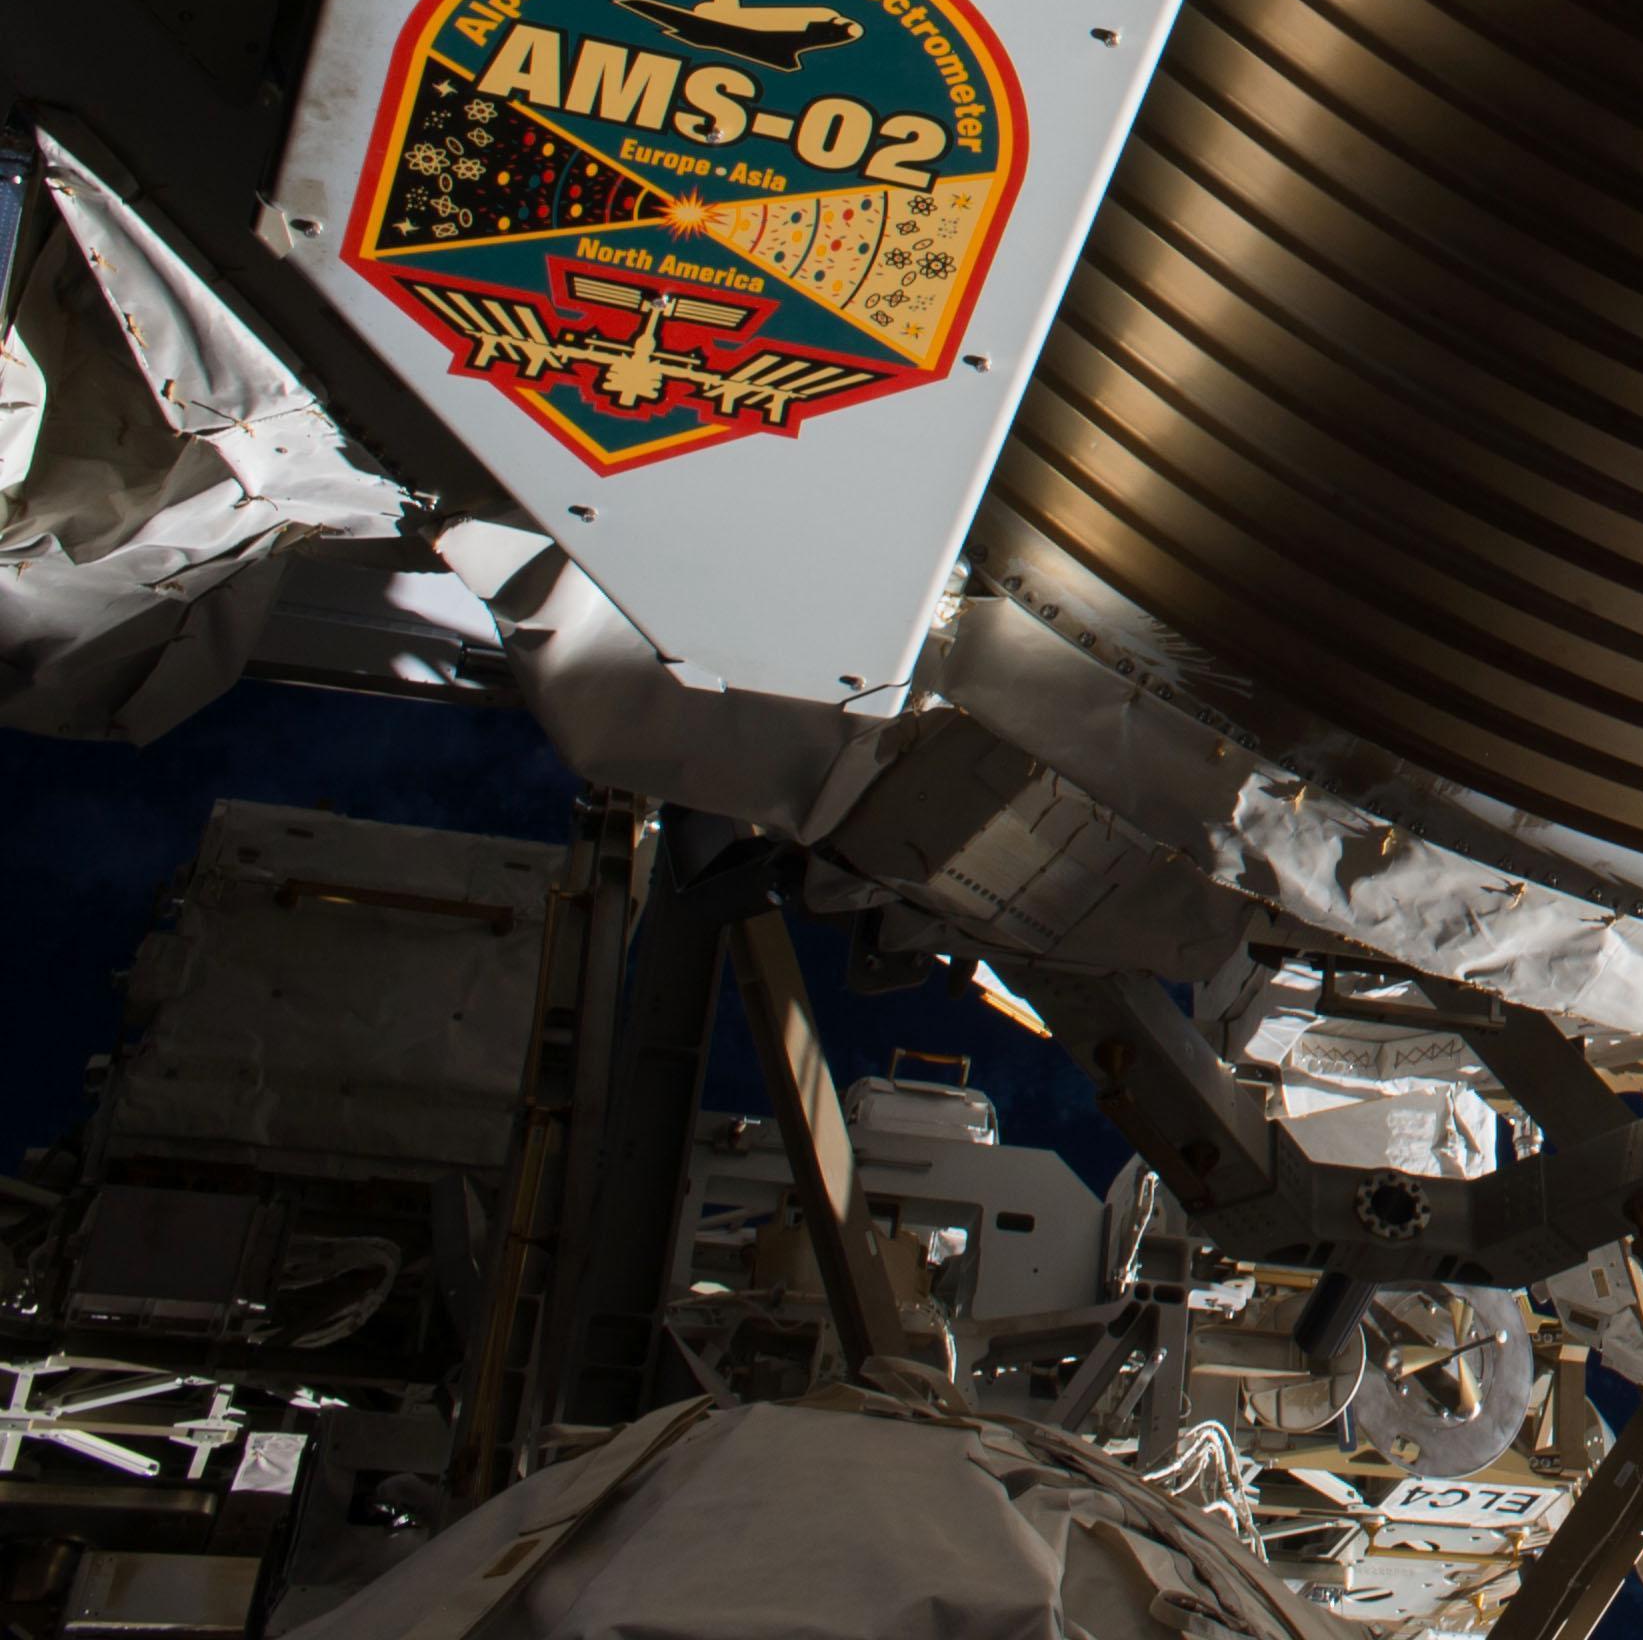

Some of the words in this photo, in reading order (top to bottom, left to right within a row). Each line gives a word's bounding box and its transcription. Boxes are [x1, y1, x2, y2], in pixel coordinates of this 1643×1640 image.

[475, 22, 950, 191] AMS-02
[619, 137, 711, 177] Europe
[727, 162, 788, 193] Asia
[576, 236, 653, 272] North
[658, 254, 766, 294] America
[1399, 1485, 1543, 1515] ELC4
